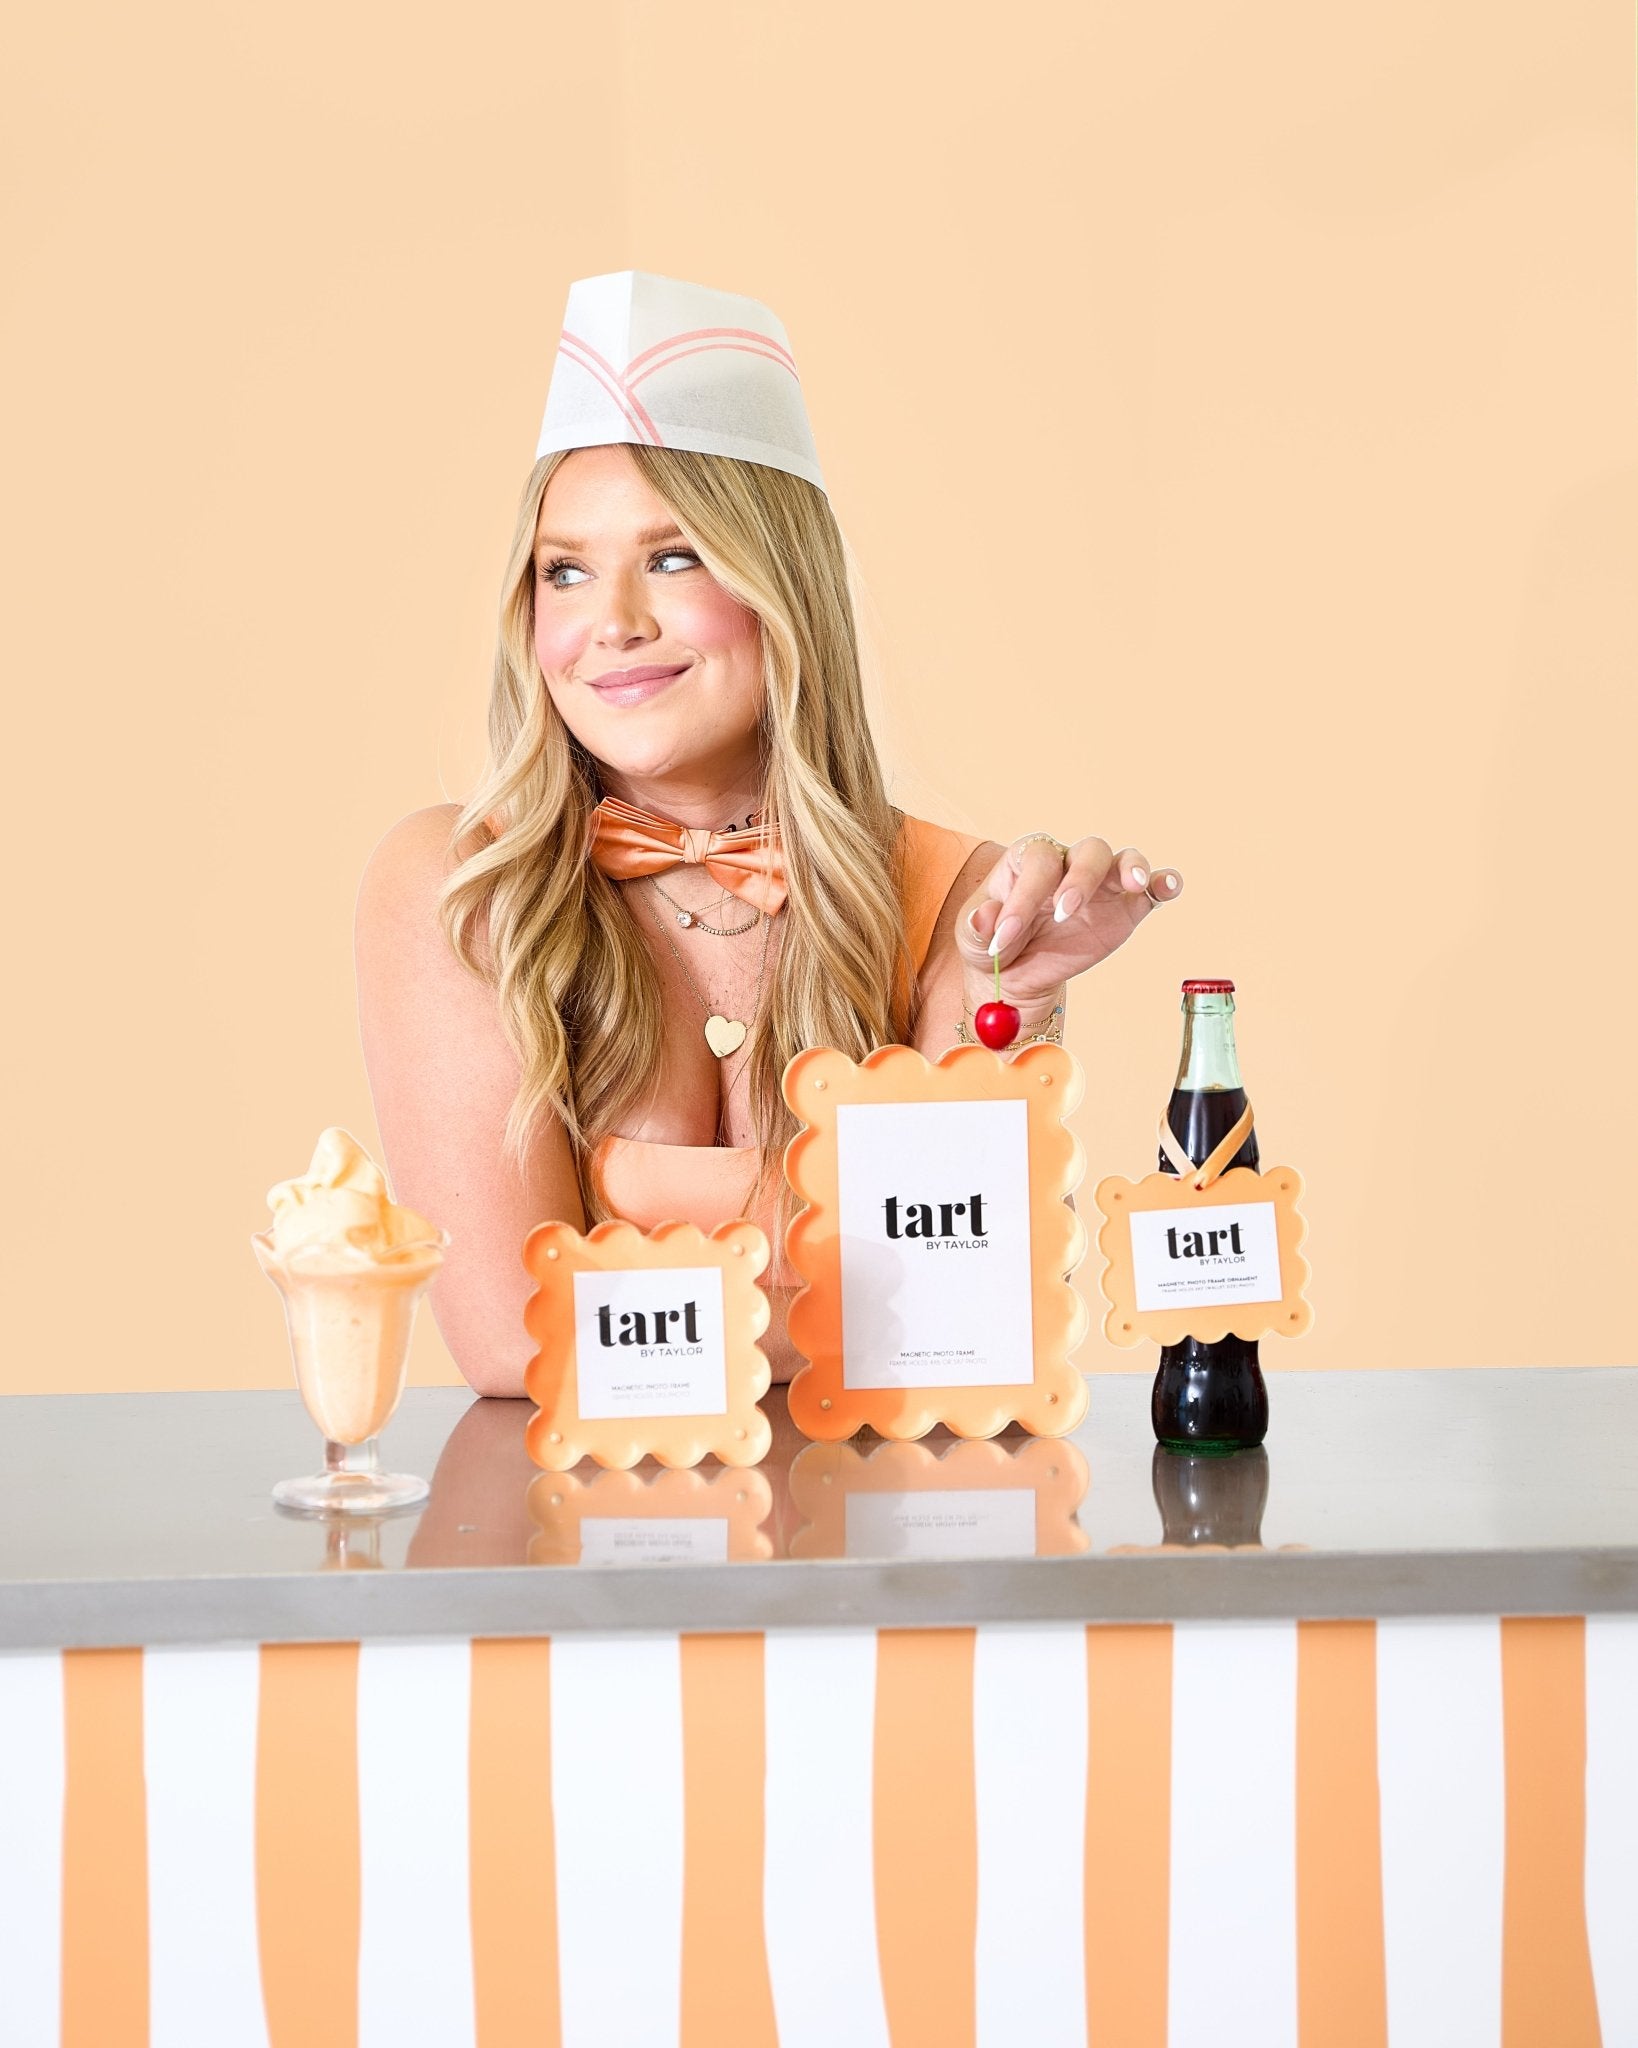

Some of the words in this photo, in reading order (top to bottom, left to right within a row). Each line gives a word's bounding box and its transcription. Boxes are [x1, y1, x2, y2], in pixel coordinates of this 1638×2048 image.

[881, 1193, 989, 1240] tart
[926, 1241, 941, 1250] BY
[943, 1239, 989, 1249] TAYLOR
[1163, 1222, 1246, 1260] tart
[1213, 1256, 1246, 1265] TAYLOR
[1227, 1275, 1258, 1283] ORNAMENT
[594, 1300, 703, 1348] tart
[641, 1349, 655, 1358] BY
[659, 1346, 703, 1357] TAYLOR
[900, 1351, 932, 1359] MAGNETIC
